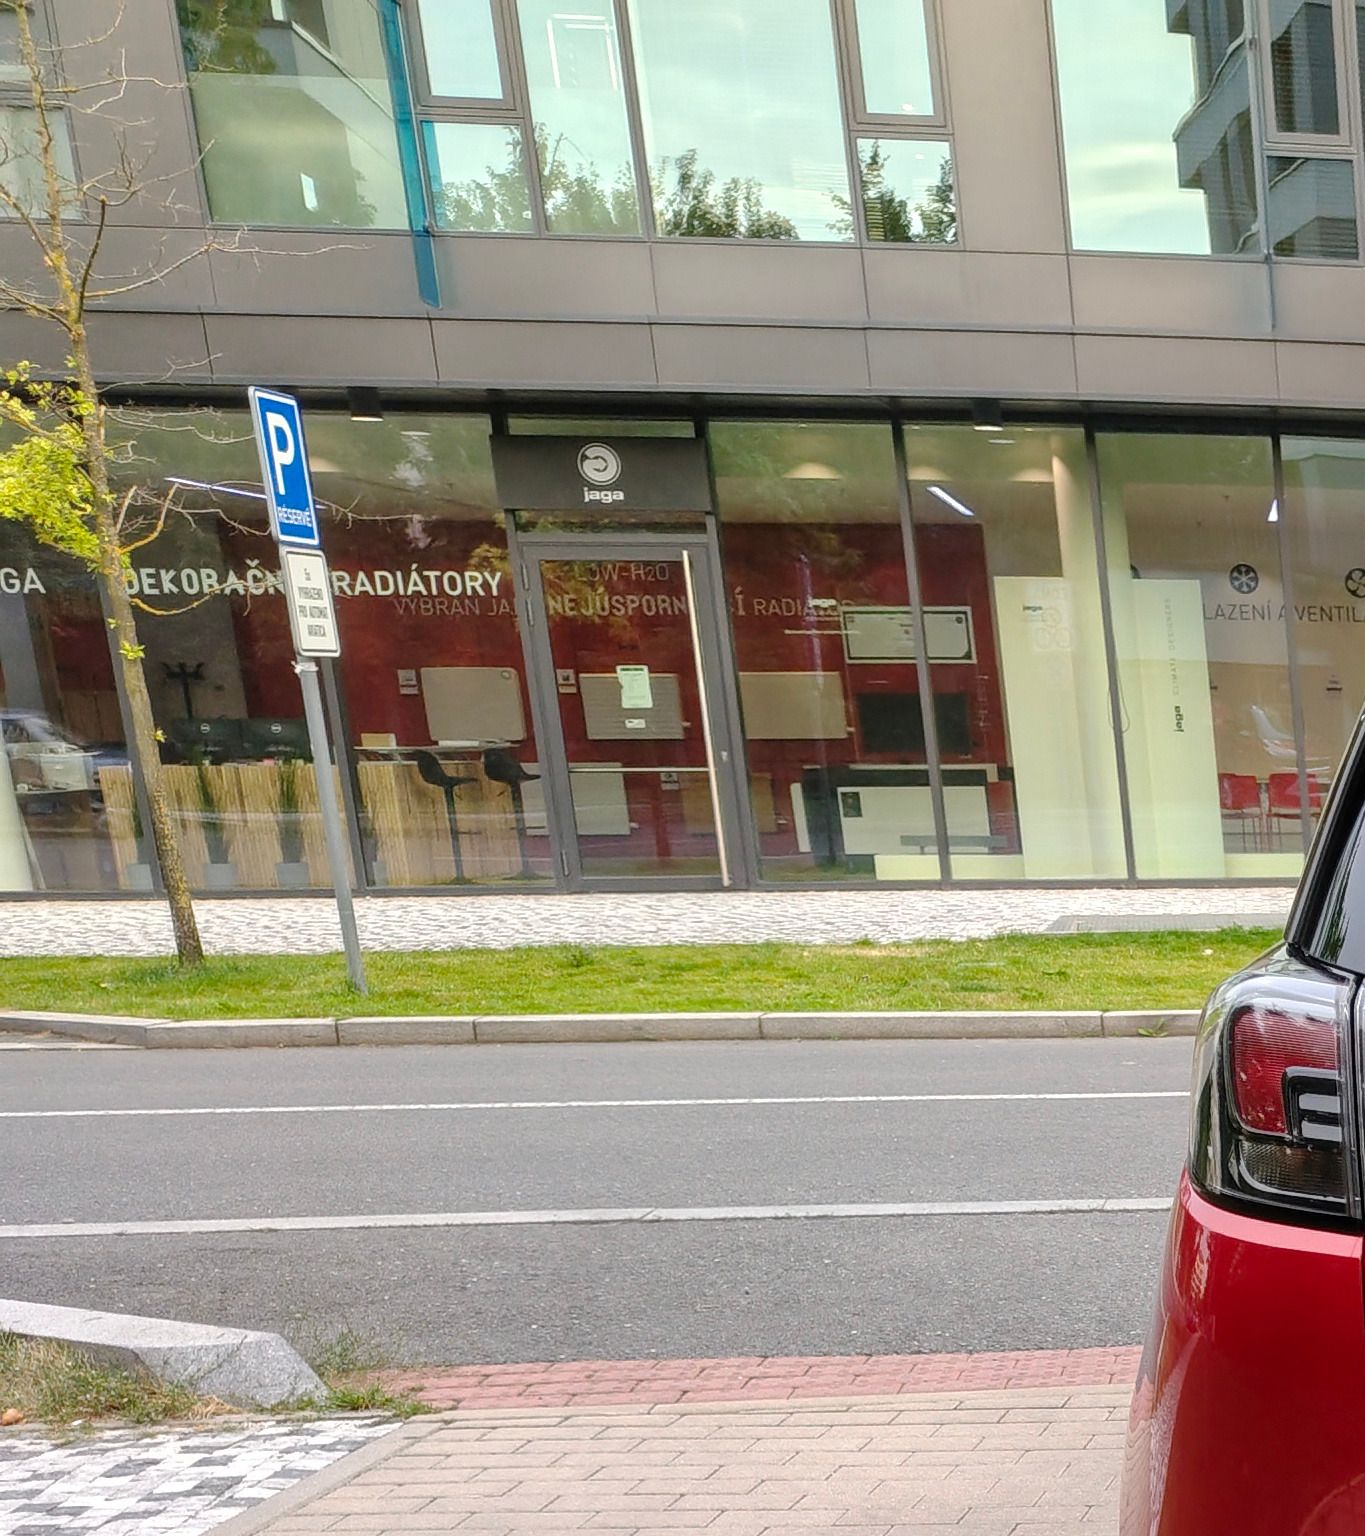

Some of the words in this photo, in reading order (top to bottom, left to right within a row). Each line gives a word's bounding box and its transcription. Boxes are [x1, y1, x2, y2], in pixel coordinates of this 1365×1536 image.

[266, 411, 295, 495] P
[583, 487, 624, 503] jaga
[124, 558, 286, 596] DEKORAČN
[332, 563, 501, 597] RADIÁTORY
